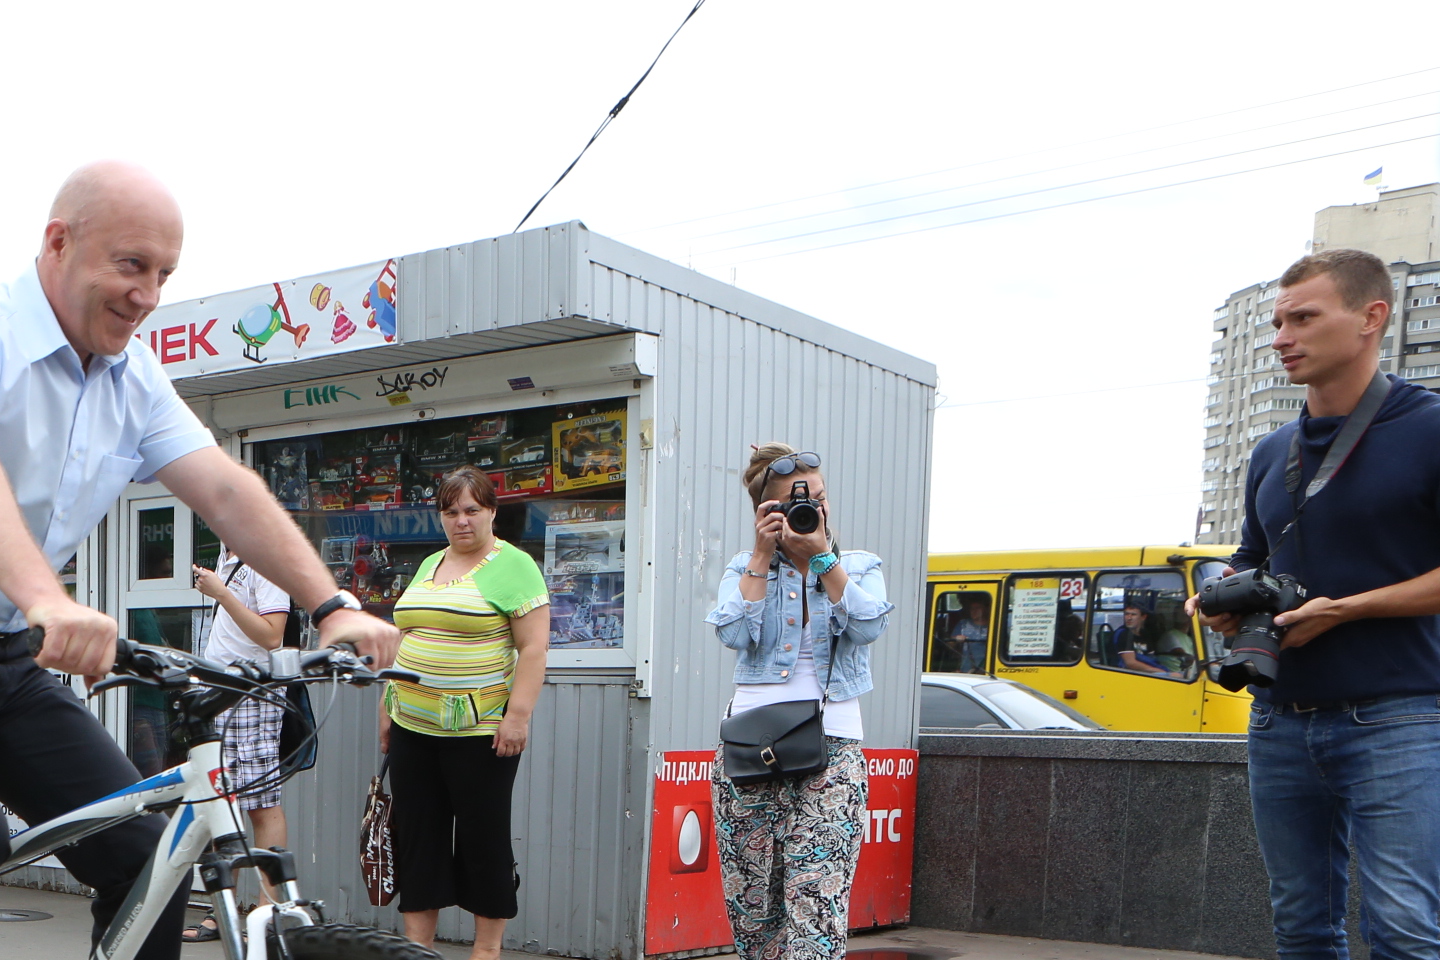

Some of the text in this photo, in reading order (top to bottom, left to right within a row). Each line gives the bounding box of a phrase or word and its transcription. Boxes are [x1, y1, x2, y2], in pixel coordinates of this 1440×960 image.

[1061, 581, 1082, 596] 23
[896, 758, 914, 779] ДО
[382, 827, 394, 894] Chocolate
[106, 927, 127, 958] POWERED
[131, 901, 144, 921] LEON
